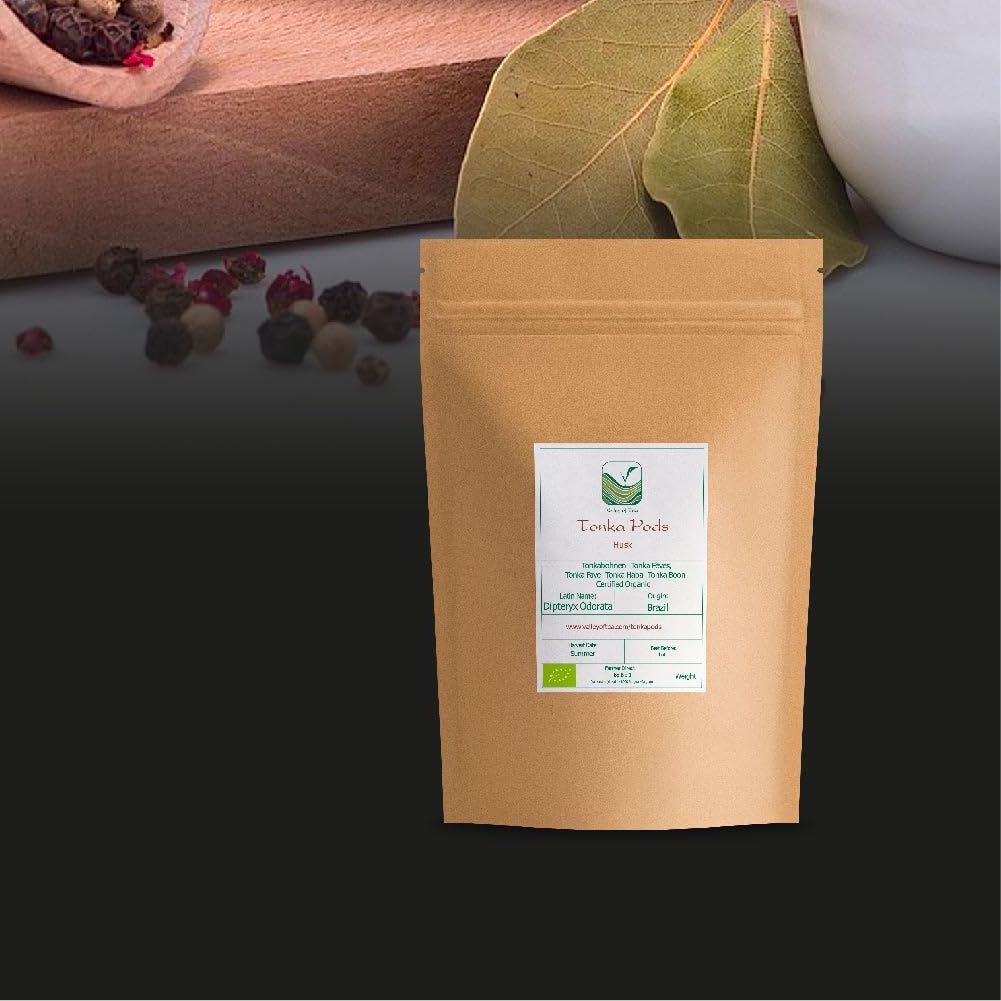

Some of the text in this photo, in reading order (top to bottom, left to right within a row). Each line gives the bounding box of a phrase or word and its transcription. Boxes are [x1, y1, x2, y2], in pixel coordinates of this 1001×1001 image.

[577, 519, 669, 532] Tonka Pods
[647, 571, 668, 579] Tonka
[596, 580, 651, 589] Certified Organic
[559, 592, 575, 600] Latin
[543, 602, 613, 612] Dipteryx Odorata
[647, 603, 669, 612] Brazil
